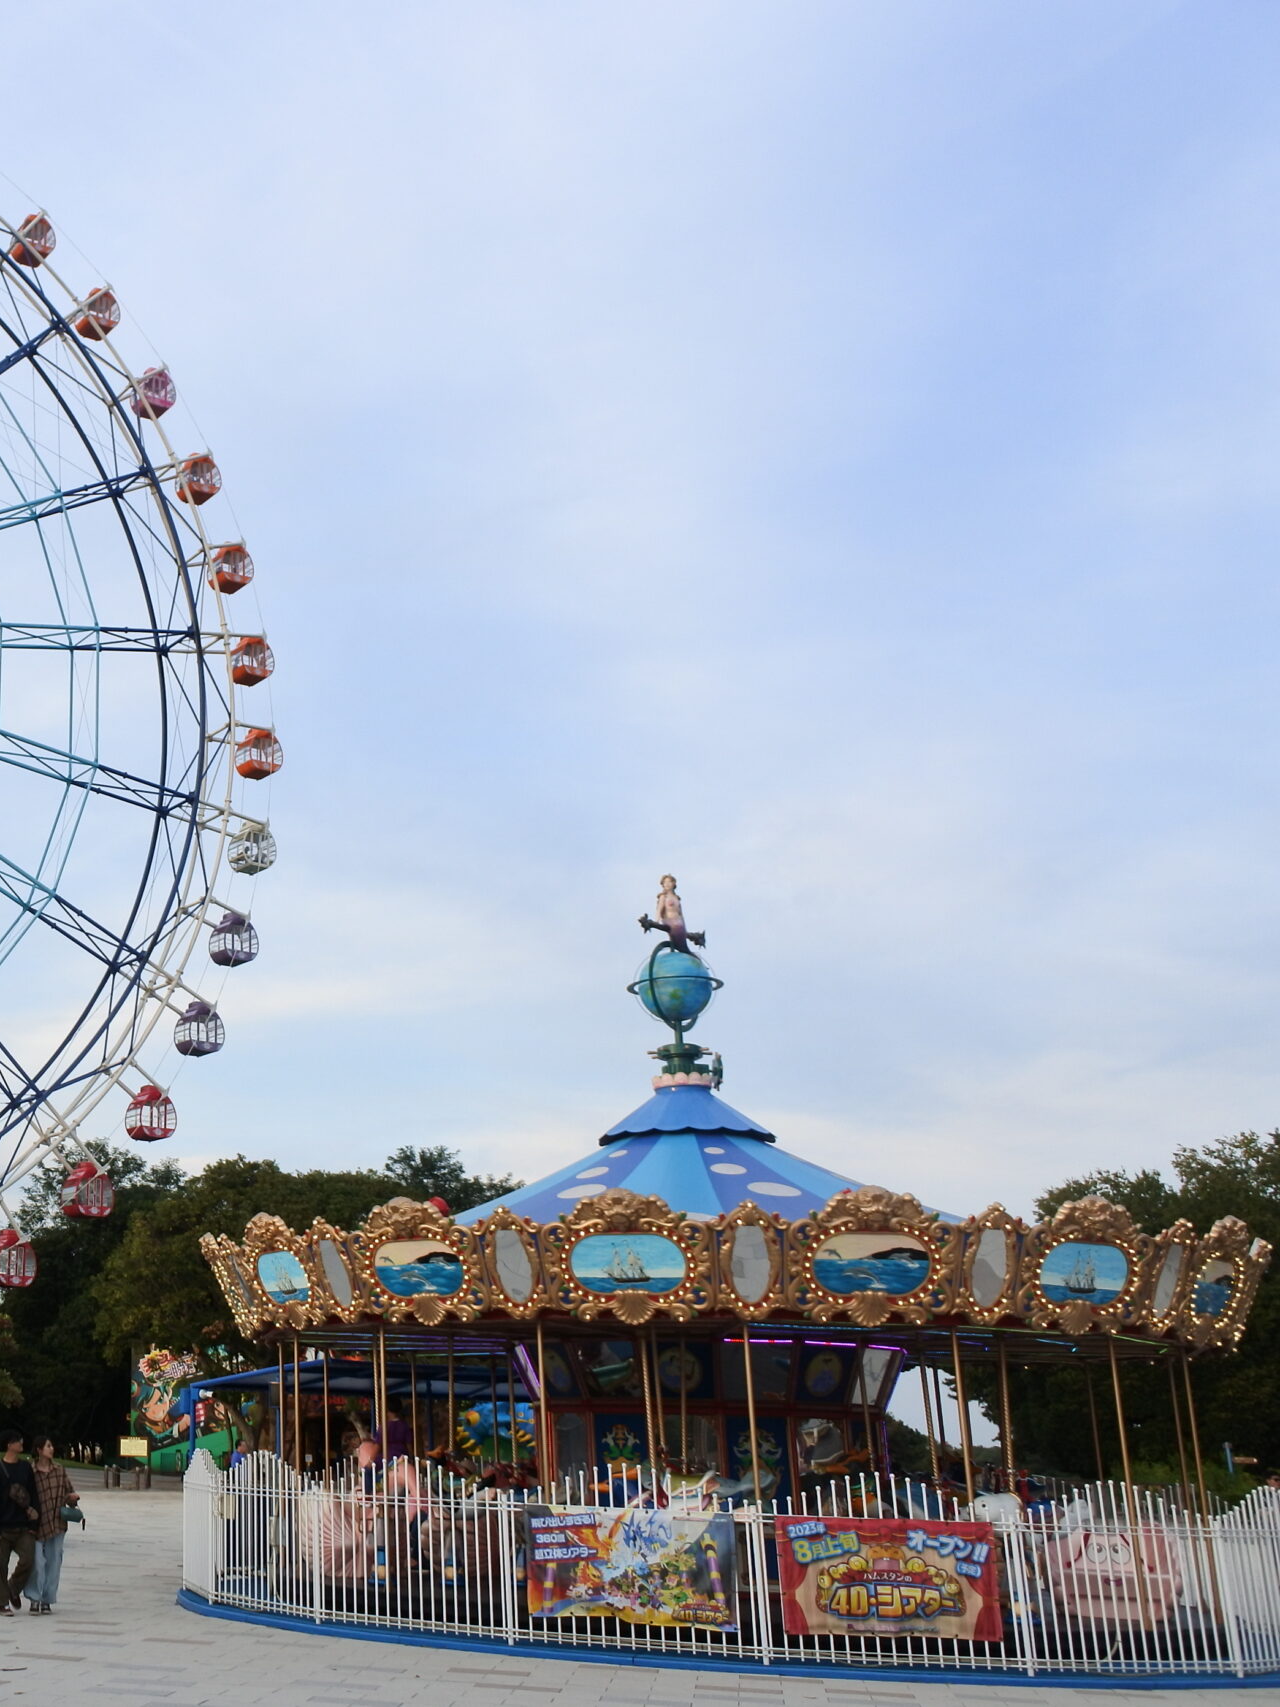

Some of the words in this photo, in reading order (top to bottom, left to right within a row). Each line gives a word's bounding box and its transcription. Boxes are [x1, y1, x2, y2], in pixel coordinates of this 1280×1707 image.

[787, 1522, 827, 1537] 2023年
[794, 1532, 859, 1563] 8月上旬
[863, 1572, 913, 1582] ハムスタンの
